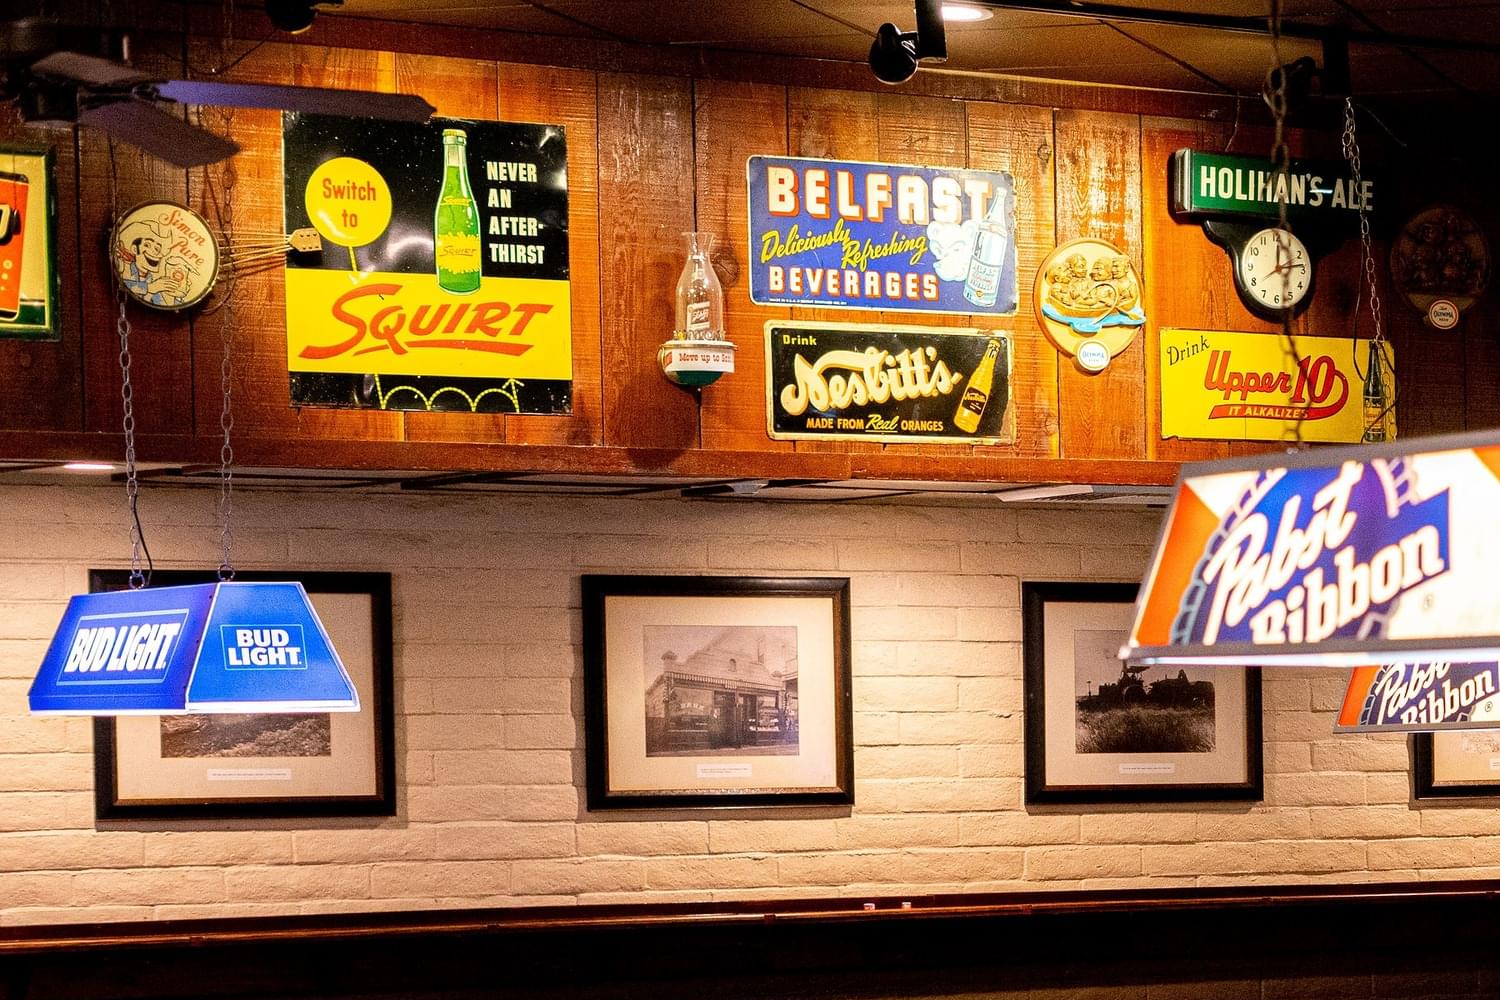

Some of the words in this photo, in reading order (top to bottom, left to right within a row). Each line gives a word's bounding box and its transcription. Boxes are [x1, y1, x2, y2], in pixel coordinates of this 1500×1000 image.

[487, 161, 537, 182] NEVER
[323, 178, 377, 202] Switch
[488, 188, 511, 208] AN
[767, 166, 993, 226] BELFAST
[1200, 166, 1324, 207] HOLIHAN'S
[1331, 178, 1374, 211] ALE
[158, 209, 206, 246] Simon
[342, 210, 358, 228] to
[489, 216, 544, 236] AFTER-
[761, 218, 850, 264] Deliciously
[841, 231, 928, 272] Refreshing
[1260, 236, 1267, 246] 11
[167, 236, 205, 268] Pure
[489, 243, 545, 264] THIRST
[1250, 247, 1259, 257] 10
[1297, 250, 1302, 260] 2
[768, 266, 940, 301] BEVERAGES
[1251, 277, 1257, 287] 8
[1297, 281, 1303, 290] 4
[1261, 290, 1267, 299] 7
[1274, 294, 1280, 304] 6
[1287, 292, 1293, 301] 5
[298, 283, 553, 360] SQUIRT
[783, 334, 817, 346] Drink
[1167, 335, 1210, 365] Drink
[781, 346, 963, 416] Nesbitt's
[1204, 350, 1292, 401] Upper
[1290, 355, 1336, 404] 10
[806, 418, 833, 430] MADE
[837, 418, 864, 430] FROM
[866, 413, 898, 431] Real
[901, 420, 944, 431] ORANGES
[1229, 406, 1239, 416] IT
[1244, 406, 1308, 418] ALKALIZES
[1203, 461, 1365, 646] Pabst
[1250, 525, 1444, 645] Ribbon
[236, 629, 289, 648] BUD
[64, 626, 117, 673] BUD
[1400, 670, 1495, 724] Ribbon
